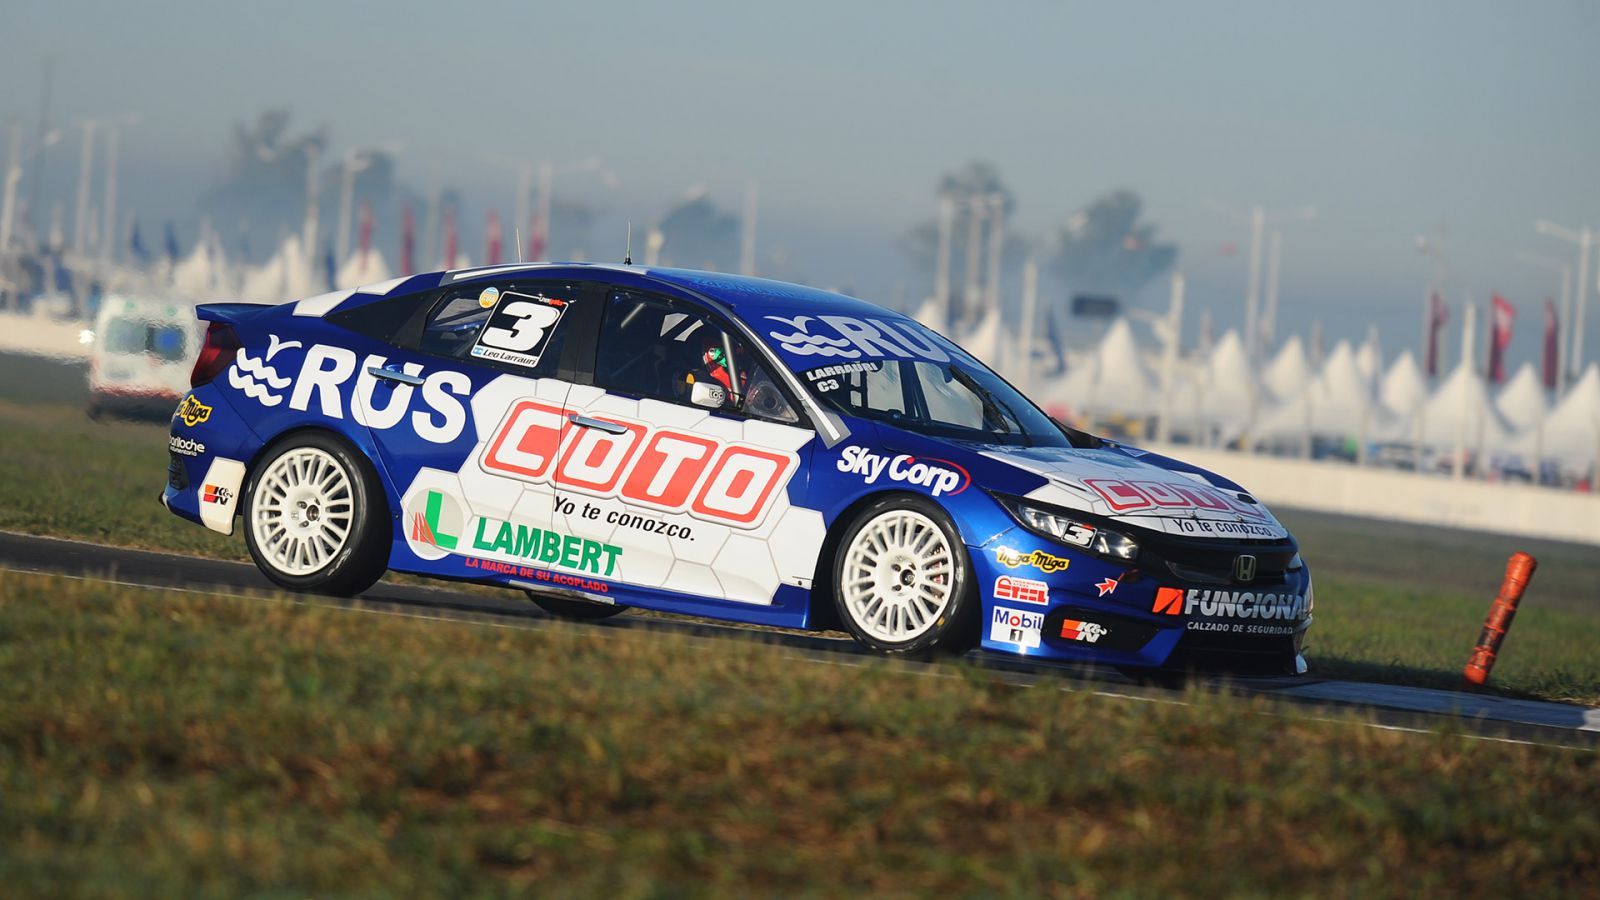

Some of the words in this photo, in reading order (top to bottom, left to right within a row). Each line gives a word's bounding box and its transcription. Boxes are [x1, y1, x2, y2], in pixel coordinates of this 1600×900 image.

[482, 301, 560, 352] 3
[483, 348, 500, 359] Leo
[500, 352, 538, 366] Larrauri
[806, 362, 879, 381] LARRAURI
[289, 344, 472, 444] RUS
[817, 379, 840, 393] C3
[485, 401, 790, 523] COTO
[837, 446, 889, 484] Sky
[889, 454, 959, 496] Corp
[553, 496, 576, 515] Yo
[583, 502, 600, 520] te
[606, 510, 696, 541] conozco.
[1173, 519, 1195, 533] Yo
[1199, 521, 1213, 533] te
[1216, 523, 1277, 538] conozco.
[1064, 526, 1094, 545] 3
[473, 517, 623, 577] LAMBERT
[465, 557, 479, 568] LA
[481, 560, 517, 576] MARCA
[519, 567, 534, 579] DE
[536, 570, 550, 582] SU
[553, 574, 609, 593] ACOPLADO
[995, 609, 1042, 630] Mobil
[1187, 621, 1229, 632] CALZADO
[1232, 625, 1244, 633] DE
[1076, 621, 1107, 643] K&N
